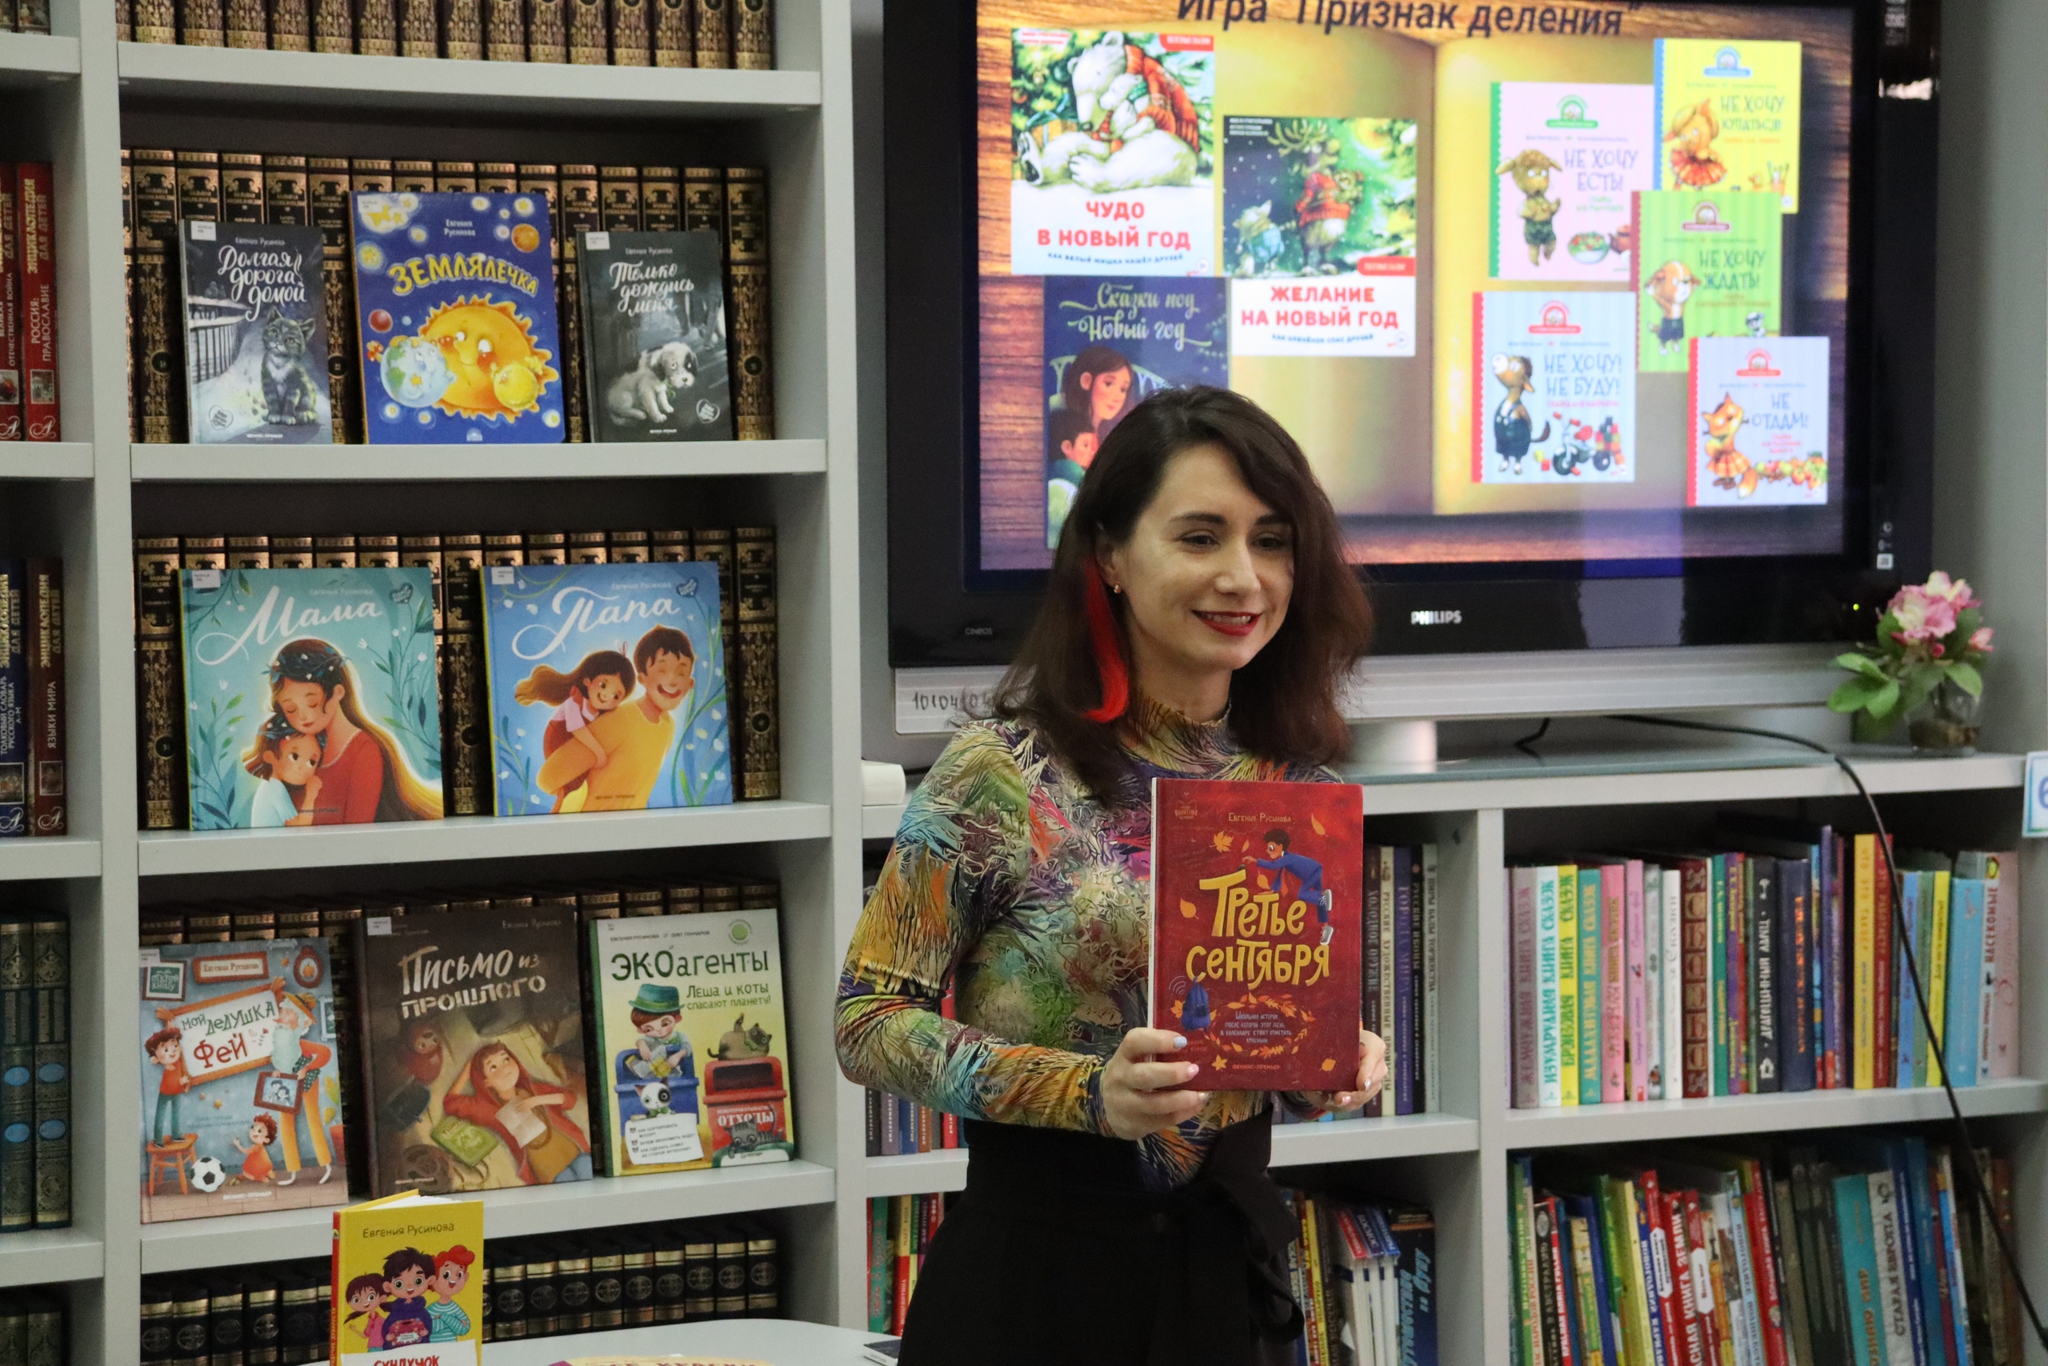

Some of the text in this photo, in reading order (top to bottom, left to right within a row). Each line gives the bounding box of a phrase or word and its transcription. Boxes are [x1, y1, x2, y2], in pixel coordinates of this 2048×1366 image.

[1564, 150, 1638, 169] НЕ ХОЧУ
[2, 193, 13, 259] ДЛЯ ДЕТЕЙ
[24, 178, 37, 274] ЭНЦИКЛОПЕДИЯ
[37, 194, 49, 261] ДЛЯ ДЕТЕЙ
[1086, 202, 1144, 221] ЧУДО
[1038, 226, 1191, 250] В НОВЫЙ ГОД
[218, 245, 296, 275] Долгая
[609, 260, 678, 290] Только
[1699, 250, 1766, 268] НЕ ХОЧУ
[229, 267, 296, 302] дорога
[245, 283, 307, 322] домой
[617, 278, 694, 313] дождись
[1078, 282, 1160, 319] Сказки
[1271, 286, 1375, 302] ЖЕЛАНИЕ
[6, 272, 16, 367] ОТЕЧЕСТВЕННАЯ ВОЙНА
[40, 283, 51, 362] ПРАВОСЛАВИЕ
[628, 299, 678, 317] меня
[1241, 306, 1398, 329] НА НОВЫЙ ГОД
[1069, 311, 1200, 351] Новый год
[1544, 353, 1623, 374] НЕ ХОЧУ!
[1546, 376, 1620, 396] НЕ БУДУ!
[1771, 393, 1790, 409] НЕ
[1752, 413, 1808, 429] ОТДАМ!
[10, 589, 21, 654] ДЛЯ ДЕТЕЙ
[39, 574, 50, 668] ЭНЦИКЛОПЕДИЯ
[50, 590, 61, 654] ДЛЯ ДЕТЕЙ
[195, 585, 382, 665] Мама
[511, 586, 680, 660] Папа
[1410, 610, 1462, 625] PHILIPS
[7, 682, 15, 707] ЯЗЫКА
[47, 681, 57, 749] ЯЗЫКИ МИРА
[1366, 890, 1379, 944] ХОЛОДНОЕ
[1984, 886, 1998, 963] НАСЕКОМЫЕ
[519, 957, 540, 969] из
[610, 948, 769, 981] ЭКОагенты
[1519, 938, 1532, 982] КНИГА
[1541, 936, 1555, 983] КНИГА
[1560, 936, 1574, 979] КНИГА
[724, 986, 733, 996] и
[1542, 988, 1557, 1083] ИЗУМРУДНАЯ
[362, 1222, 455, 1239] Евгения Русинова
[1672, 1213, 1703, 1366] АСНАЯ КНИГА ЗЕМЛИ
[1888, 1275, 1905, 1336] СТАРАЯ
[1399, 1269, 1416, 1366] утешествие
